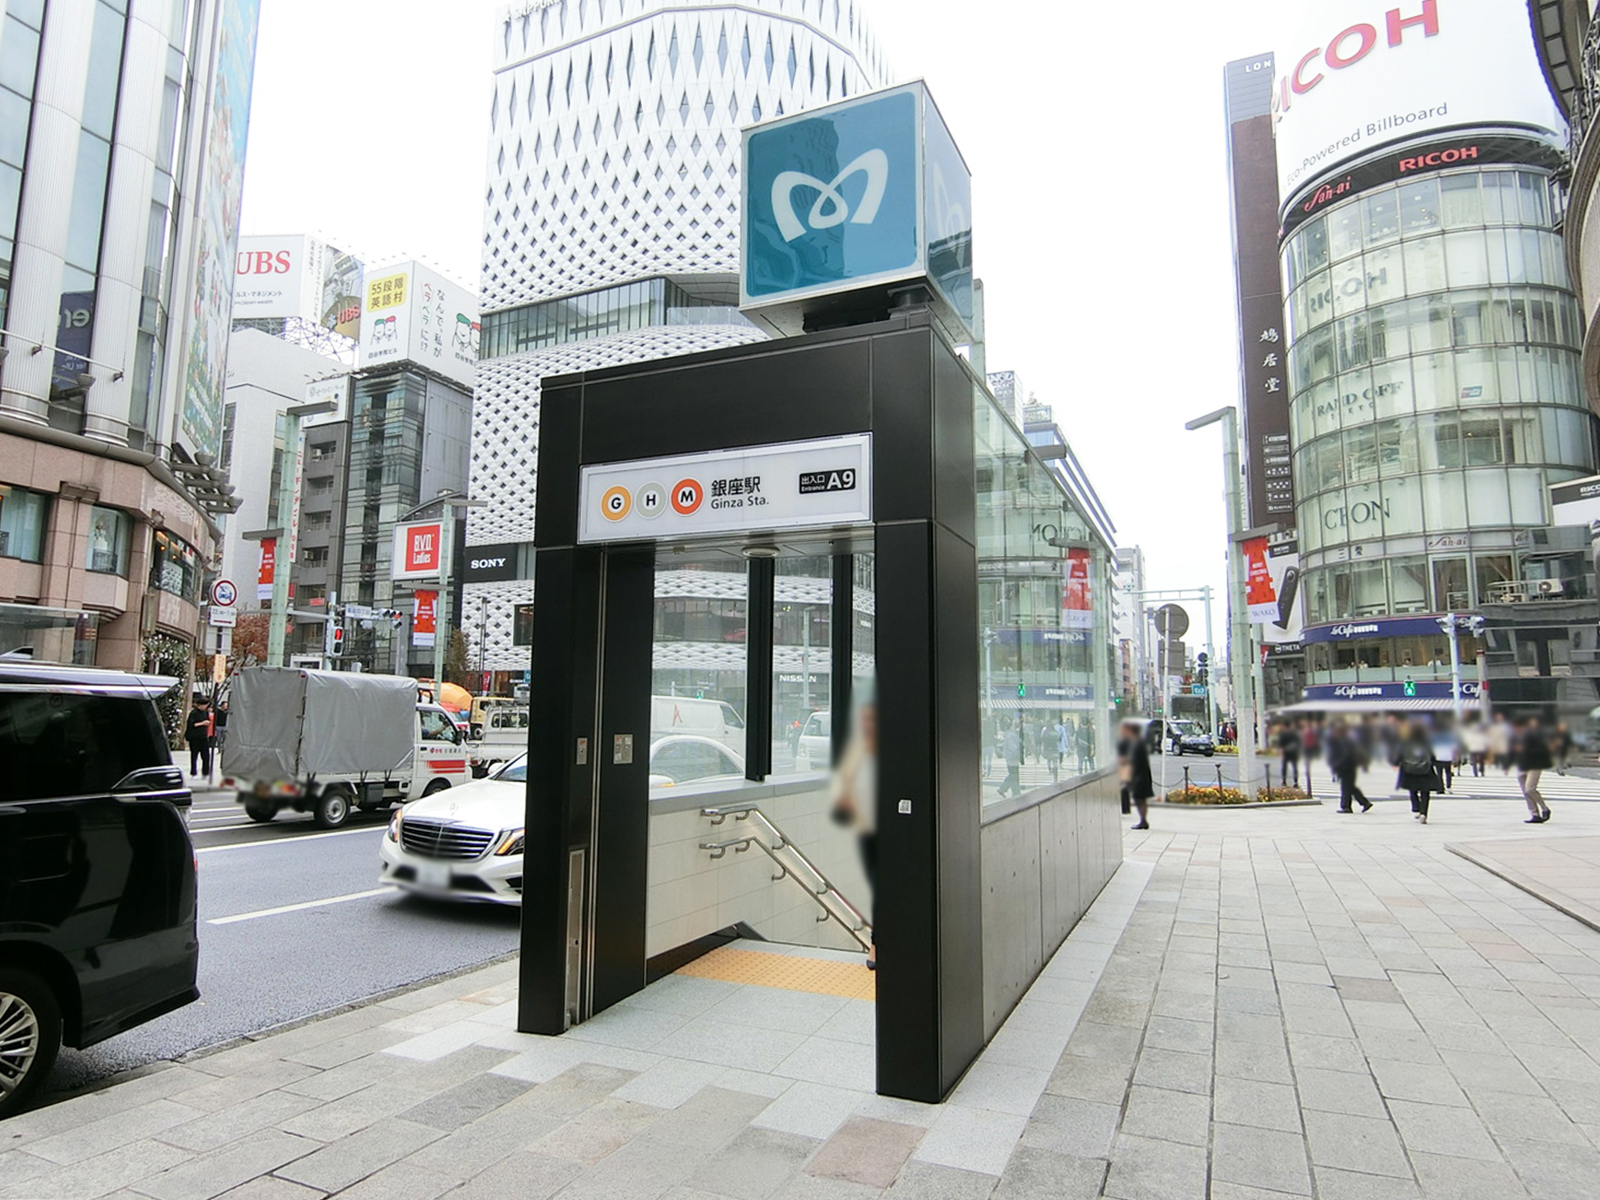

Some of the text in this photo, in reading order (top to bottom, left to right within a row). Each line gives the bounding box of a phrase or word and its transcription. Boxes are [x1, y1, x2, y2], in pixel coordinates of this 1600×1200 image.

[1366, 102, 1449, 137] Billboard
[1399, 146, 1478, 172] RICOH
[236, 250, 291, 275] UBS
[371, 276, 404, 296] 55段階
[371, 291, 403, 309] 英語村
[710, 476, 761, 498] 銀座駅
[800, 475, 825, 485] 出入口
[826, 470, 855, 490] A9
[801, 484, 826, 492] Entrance
[610, 496, 622, 509] G
[646, 494, 657, 507] H
[680, 489, 694, 503] M
[710, 496, 770, 510] Ginza Sta.
[413, 551, 431, 565] Ladies
[470, 557, 506, 569] SONY
[1281, 644, 1300, 652] THETA
[779, 674, 817, 683] NISSN
